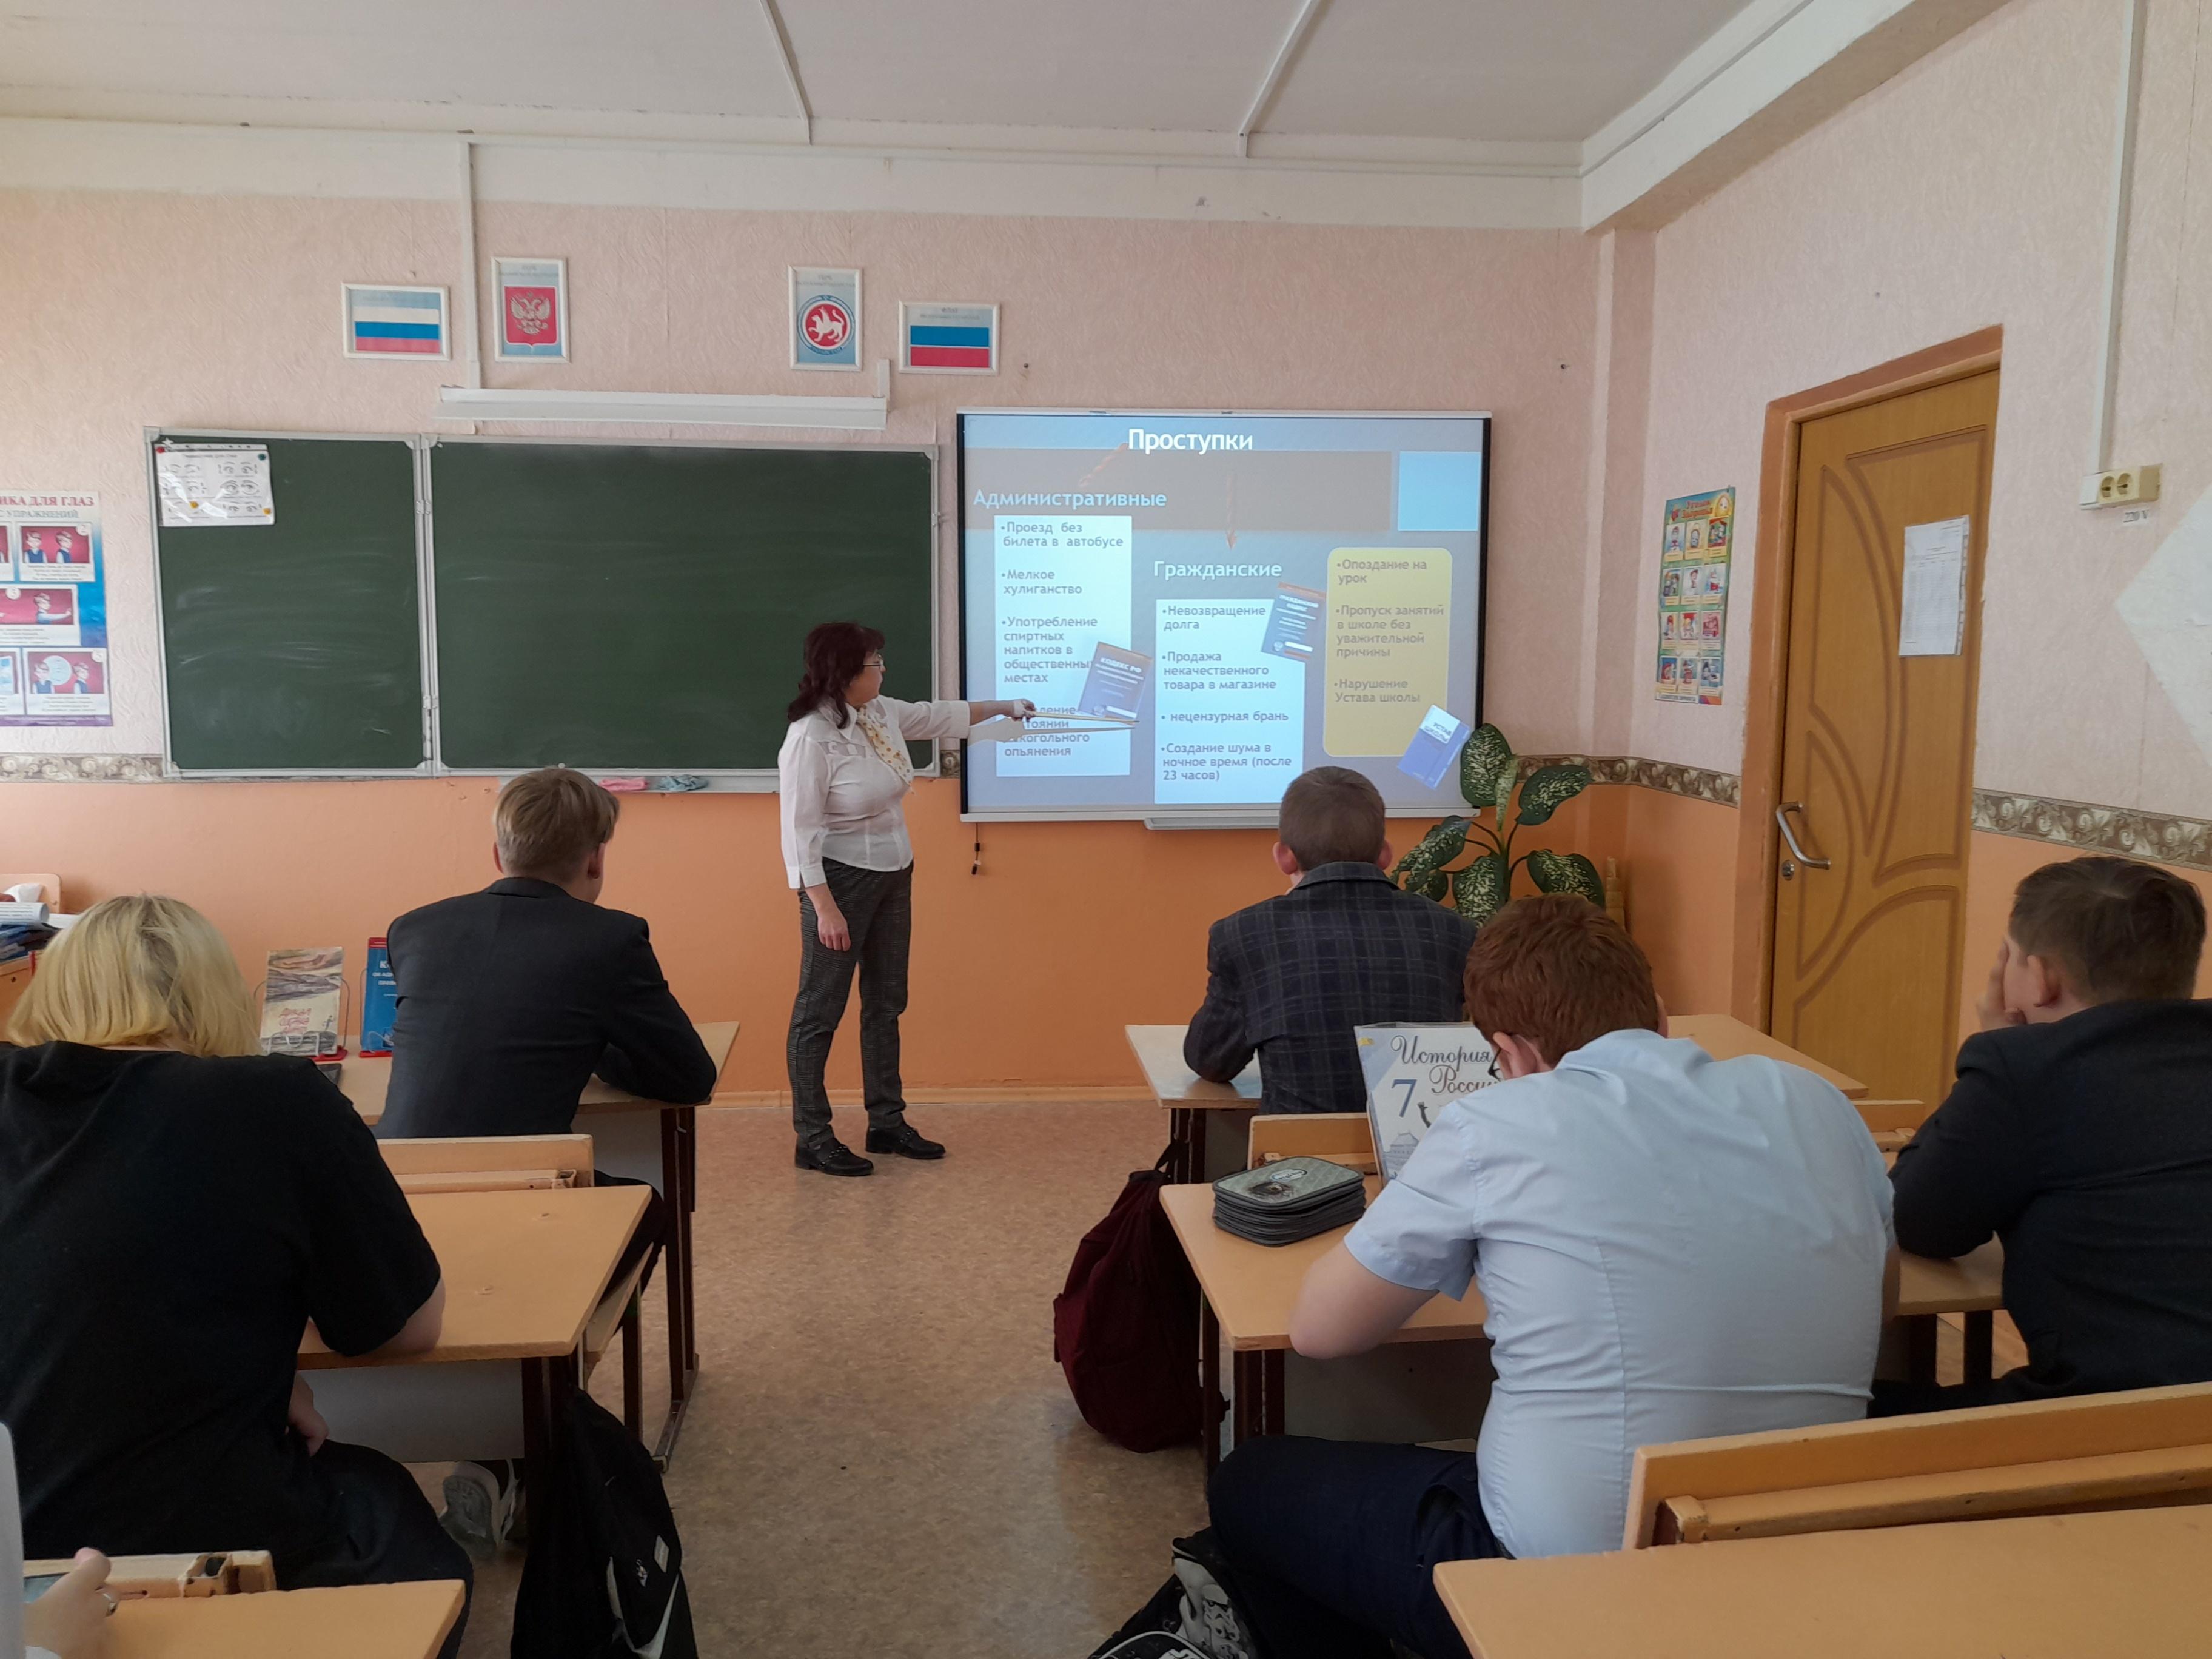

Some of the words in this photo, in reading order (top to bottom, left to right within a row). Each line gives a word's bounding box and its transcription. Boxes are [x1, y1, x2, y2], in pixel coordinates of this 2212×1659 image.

[1128, 428, 1253, 455] Проступки
[61, 497, 95, 506] ГЛАЗ
[973, 489, 1167, 510] Административные
[1007, 521, 1053, 534] Проезд
[1061, 521, 1082, 532] без
[1003, 536, 1047, 547] билета
[1052, 538, 1059, 547] в
[1067, 537, 1124, 549] автобусе
[1154, 560, 1282, 580] Гражданские
[1342, 559, 1410, 571] Опоздание
[1413, 561, 1427, 570] на
[1007, 569, 1056, 580] Мелкое
[1338, 574, 1367, 585] урок
[1003, 585, 1082, 595] хулиганство
[1168, 605, 1266, 617] Невозвращение
[1341, 605, 1392, 618] Пропуск
[1395, 604, 1444, 615] занятий
[1007, 615, 1098, 629] Употребление
[1164, 620, 1199, 631] долга
[1337, 621, 1344, 629] в
[1347, 620, 1388, 630] школе
[1390, 619, 1411, 629] без
[1004, 632, 1064, 643] спиртных
[1336, 632, 1425, 645] уважительной
[1004, 646, 1062, 655] напитков
[1066, 646, 1073, 655] в
[1336, 648, 1391, 659] причины
[1167, 651, 1222, 663] Продажа
[1164, 667, 1270, 677] некачественного
[1004, 674, 1048, 683] местах
[1164, 681, 1205, 691] товара
[1208, 681, 1216, 689] в
[1219, 681, 1277, 690] магазине
[1339, 679, 1409, 691] Нарушение
[1335, 692, 1376, 703] Устава
[1379, 693, 1421, 703] школы
[1170, 712, 1250, 723] нецензурная
[1253, 711, 1289, 722] брань
[1014, 734, 1090, 743] когольного
[1004, 748, 1071, 757] опьянения
[1166, 743, 1225, 754] Создание
[1228, 745, 1261, 754] шума
[1162, 758, 1207, 767] ночное
[1210, 757, 1248, 768] время
[1252, 756, 1292, 768] (после
[1163, 770, 1177, 780] 23
[1181, 770, 1220, 782] часов)
[1390, 1035, 1493, 1072] История
[1429, 1064, 1500, 1093] Росси
[1391, 1079, 1418, 1118] 7
